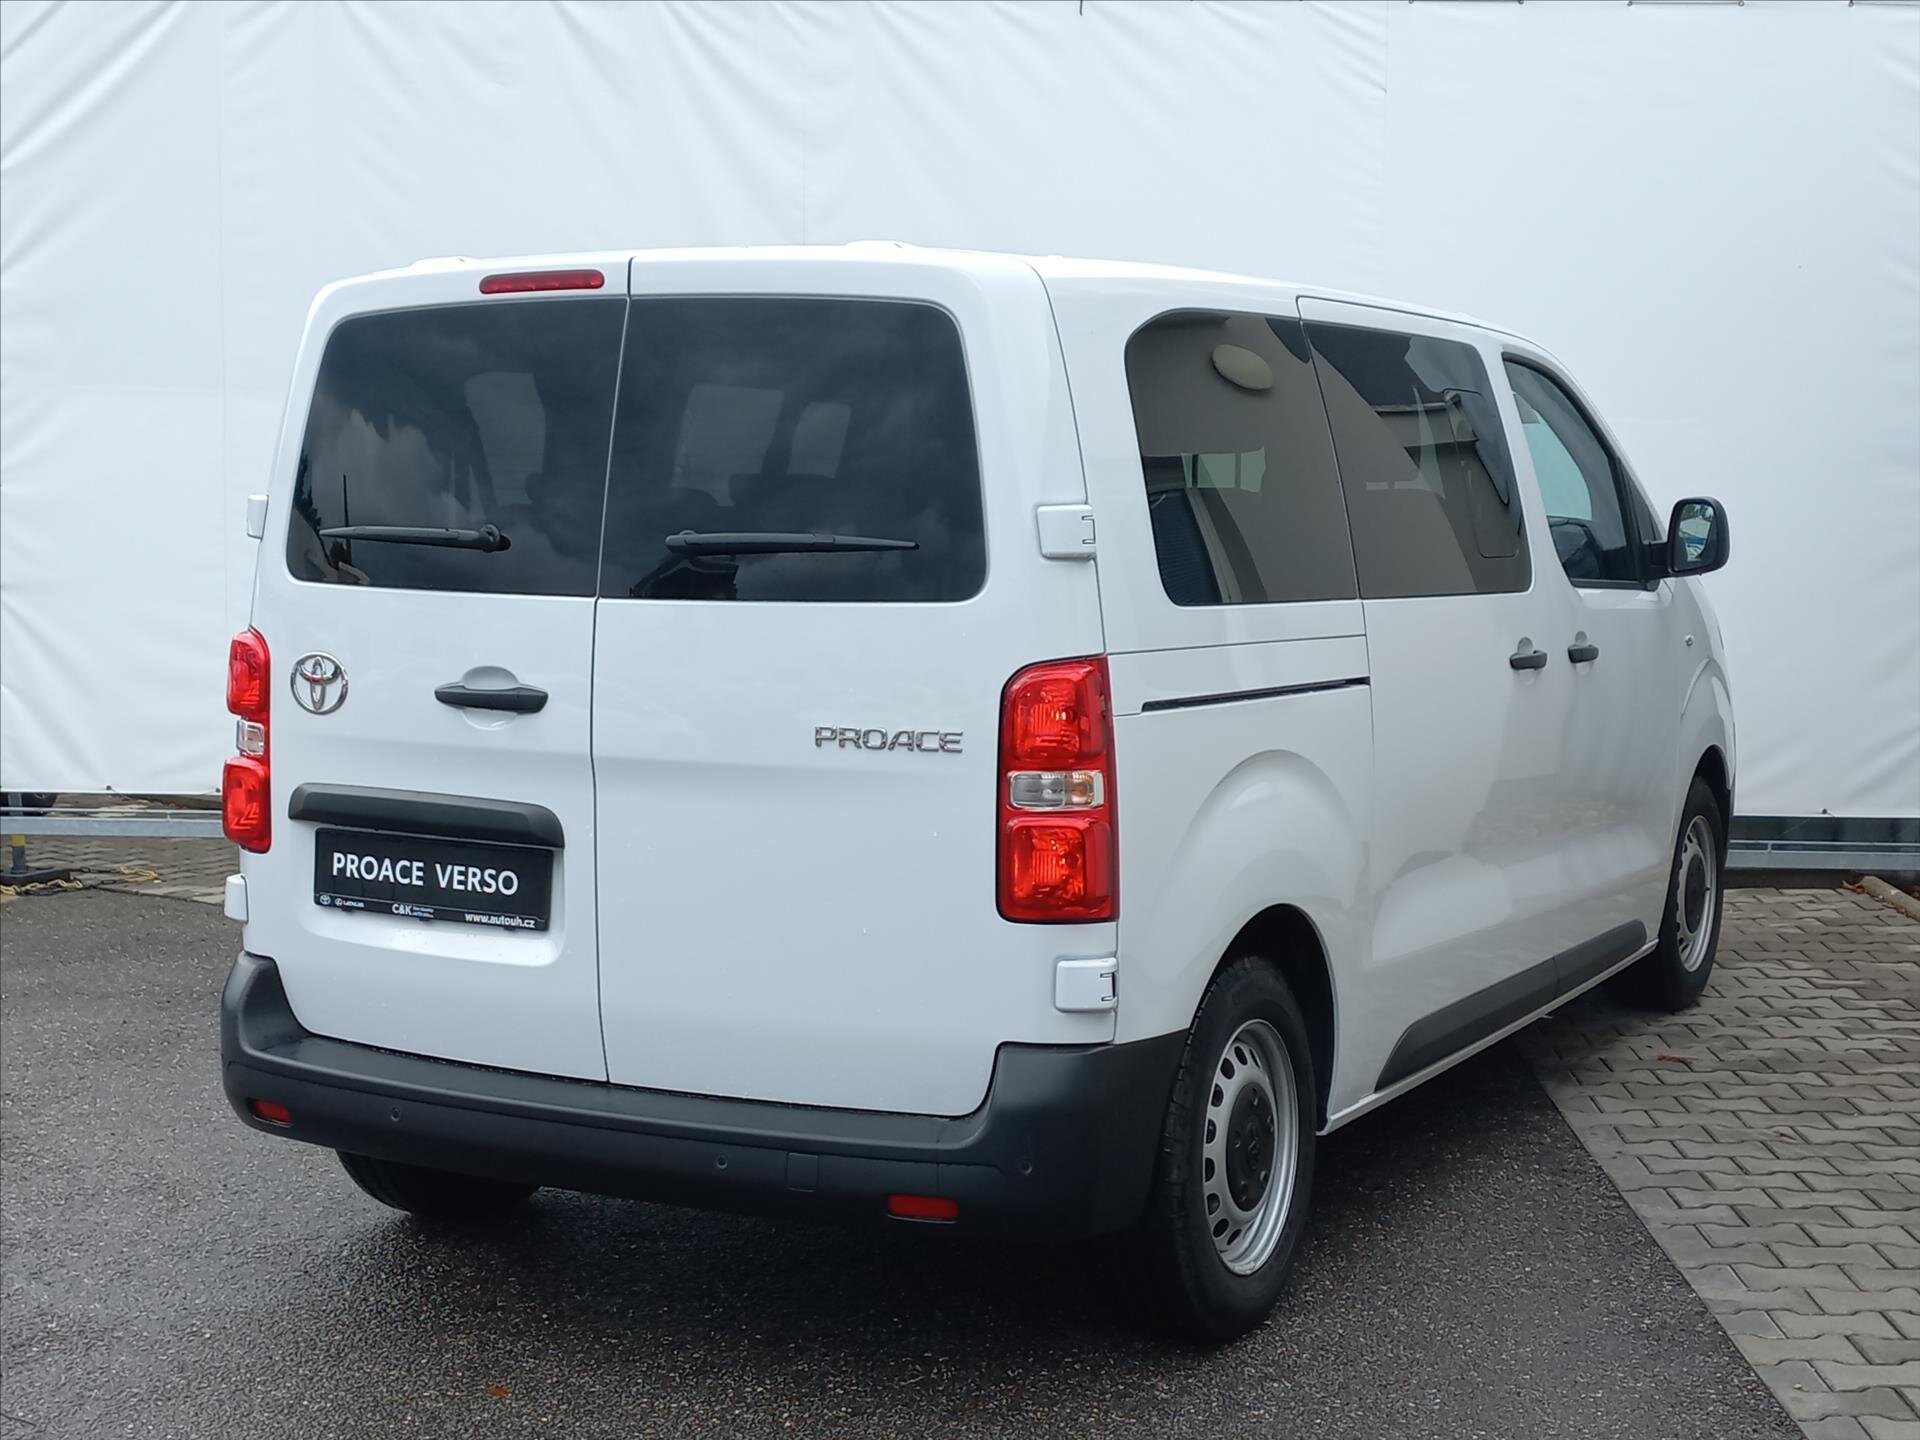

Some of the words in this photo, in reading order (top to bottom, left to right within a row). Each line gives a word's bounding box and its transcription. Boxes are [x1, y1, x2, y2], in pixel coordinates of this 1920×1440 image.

[814, 726, 964, 754] PROACE
[332, 852, 425, 887] PROACE
[435, 863, 519, 896] VERSO
[392, 903, 412, 916] C&K
[464, 913, 536, 928] www.autouh.cz
